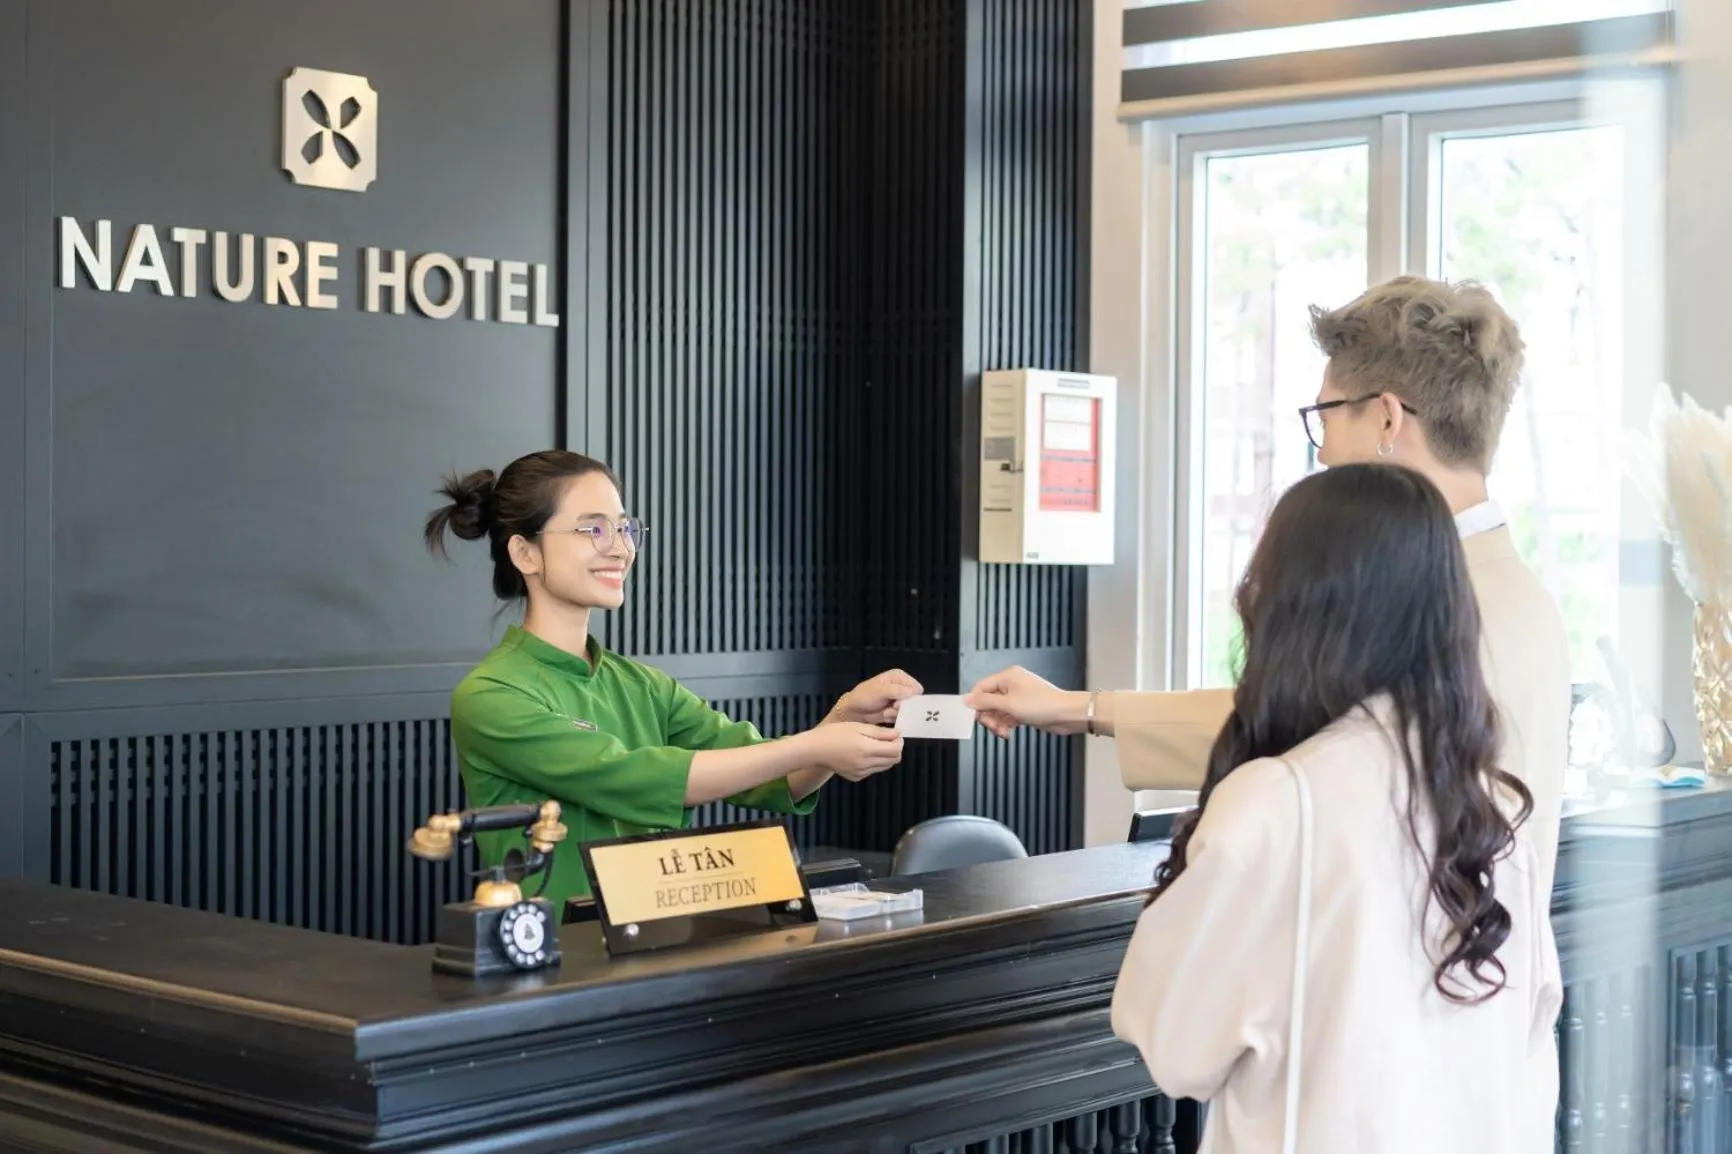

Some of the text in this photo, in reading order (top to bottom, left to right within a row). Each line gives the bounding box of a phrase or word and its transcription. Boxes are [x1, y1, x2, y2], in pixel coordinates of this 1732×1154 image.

[60, 216, 560, 327] NATURE HOTEL
[688, 846, 735, 871] TÂN
[655, 877, 757, 908] RECEPTION
